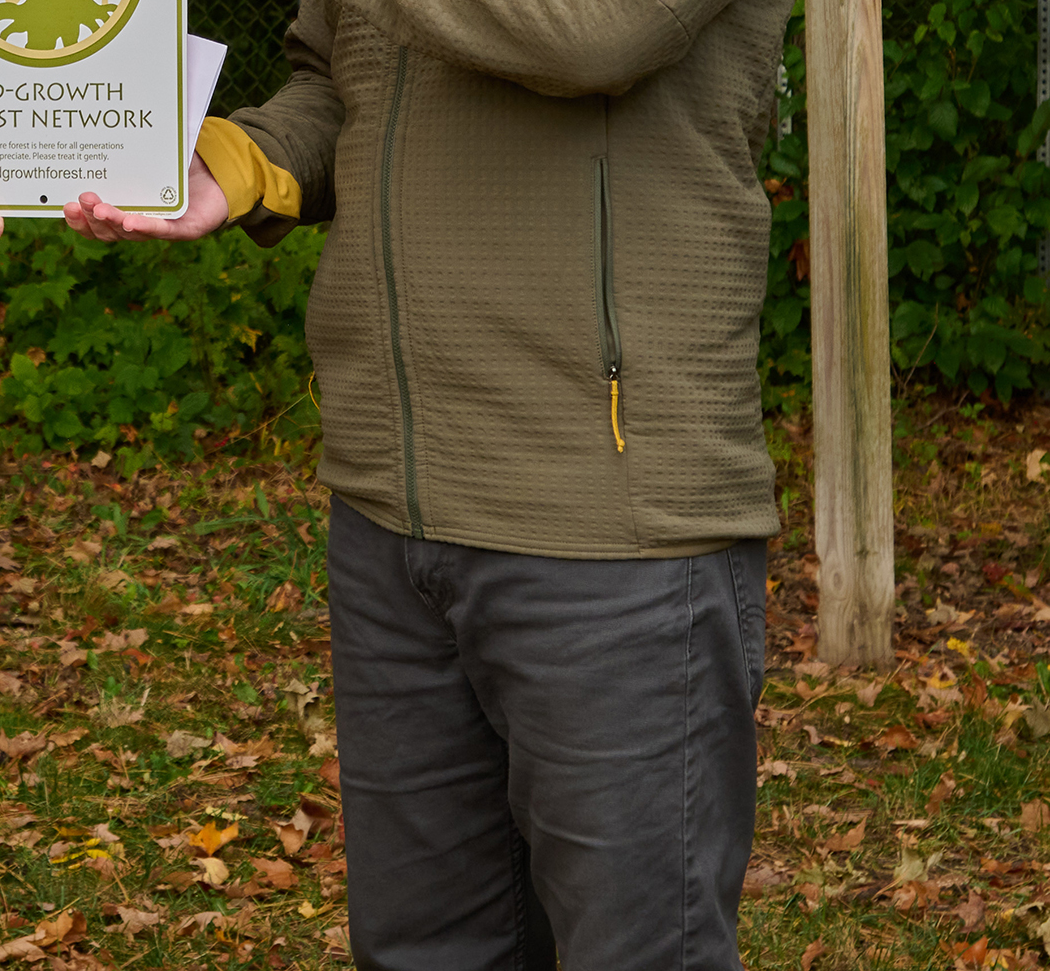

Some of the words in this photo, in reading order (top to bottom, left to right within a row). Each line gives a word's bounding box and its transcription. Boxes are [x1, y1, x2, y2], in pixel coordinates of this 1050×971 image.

[32, 109, 153, 129] NETWORK
[9, 141, 30, 149] forest
[39, 141, 55, 149] here
[57, 141, 67, 149] for
[69, 141, 78, 149] all
[79, 141, 124, 152] generations
[33, 152, 56, 160] Please
[84, 152, 108, 162] gently.
